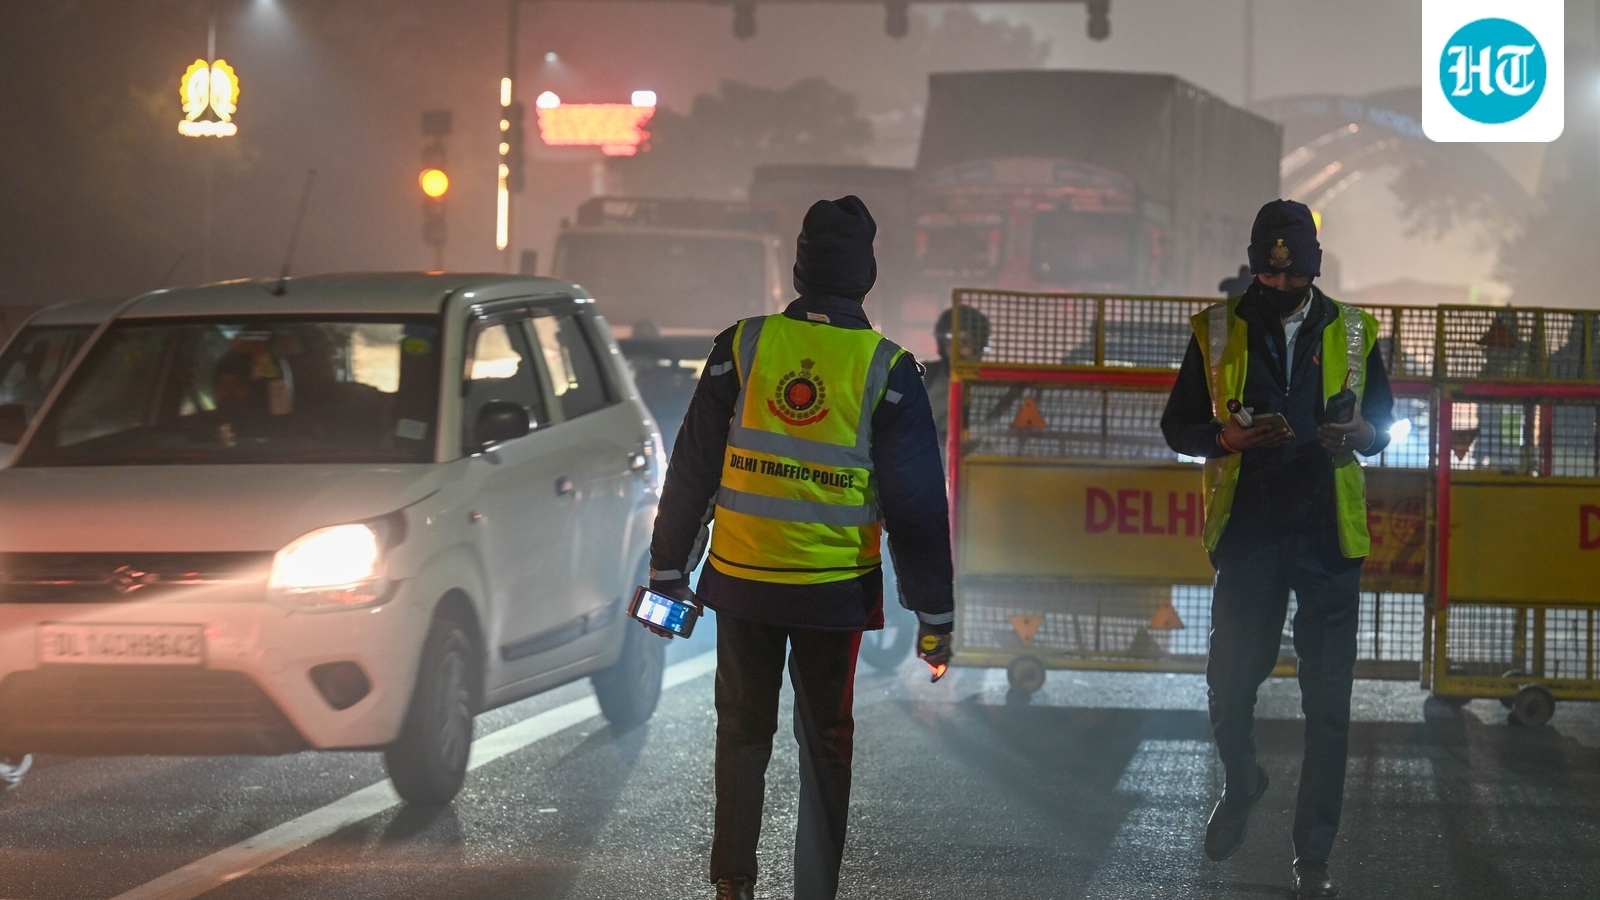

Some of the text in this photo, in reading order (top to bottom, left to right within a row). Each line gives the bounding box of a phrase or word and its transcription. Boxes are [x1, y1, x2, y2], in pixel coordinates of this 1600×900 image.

[730, 453, 855, 489] DELHI TRAFFIC POLICE
